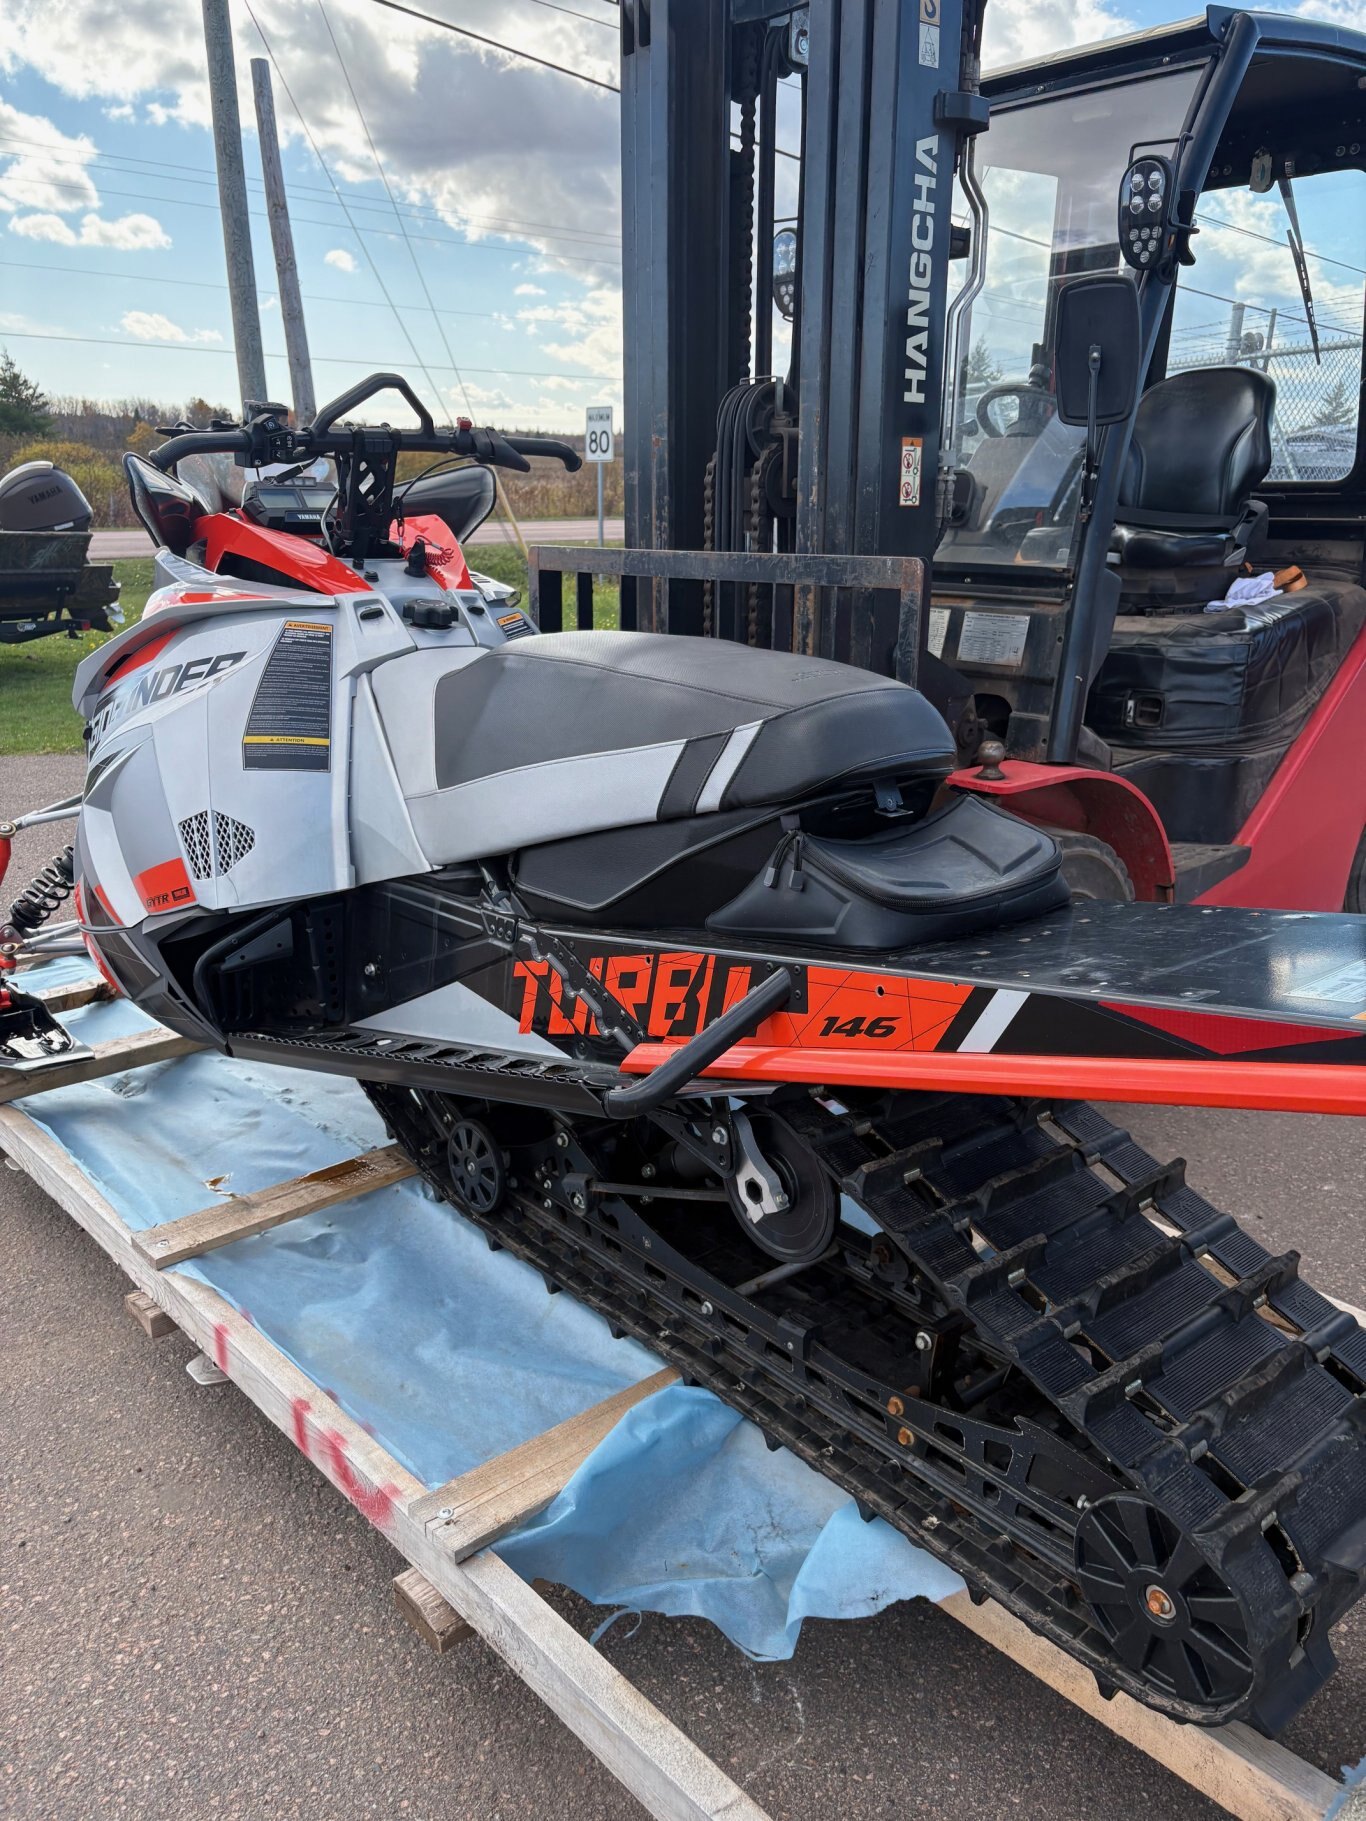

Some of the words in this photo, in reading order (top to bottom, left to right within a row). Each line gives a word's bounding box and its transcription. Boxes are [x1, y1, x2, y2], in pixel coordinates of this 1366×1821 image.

[904, 134, 939, 403] HANGCHA
[588, 430, 610, 454] 80
[28, 485, 63, 504] YAMAHA
[146, 892, 169, 908] GYTR
[818, 1016, 902, 1038] 146
